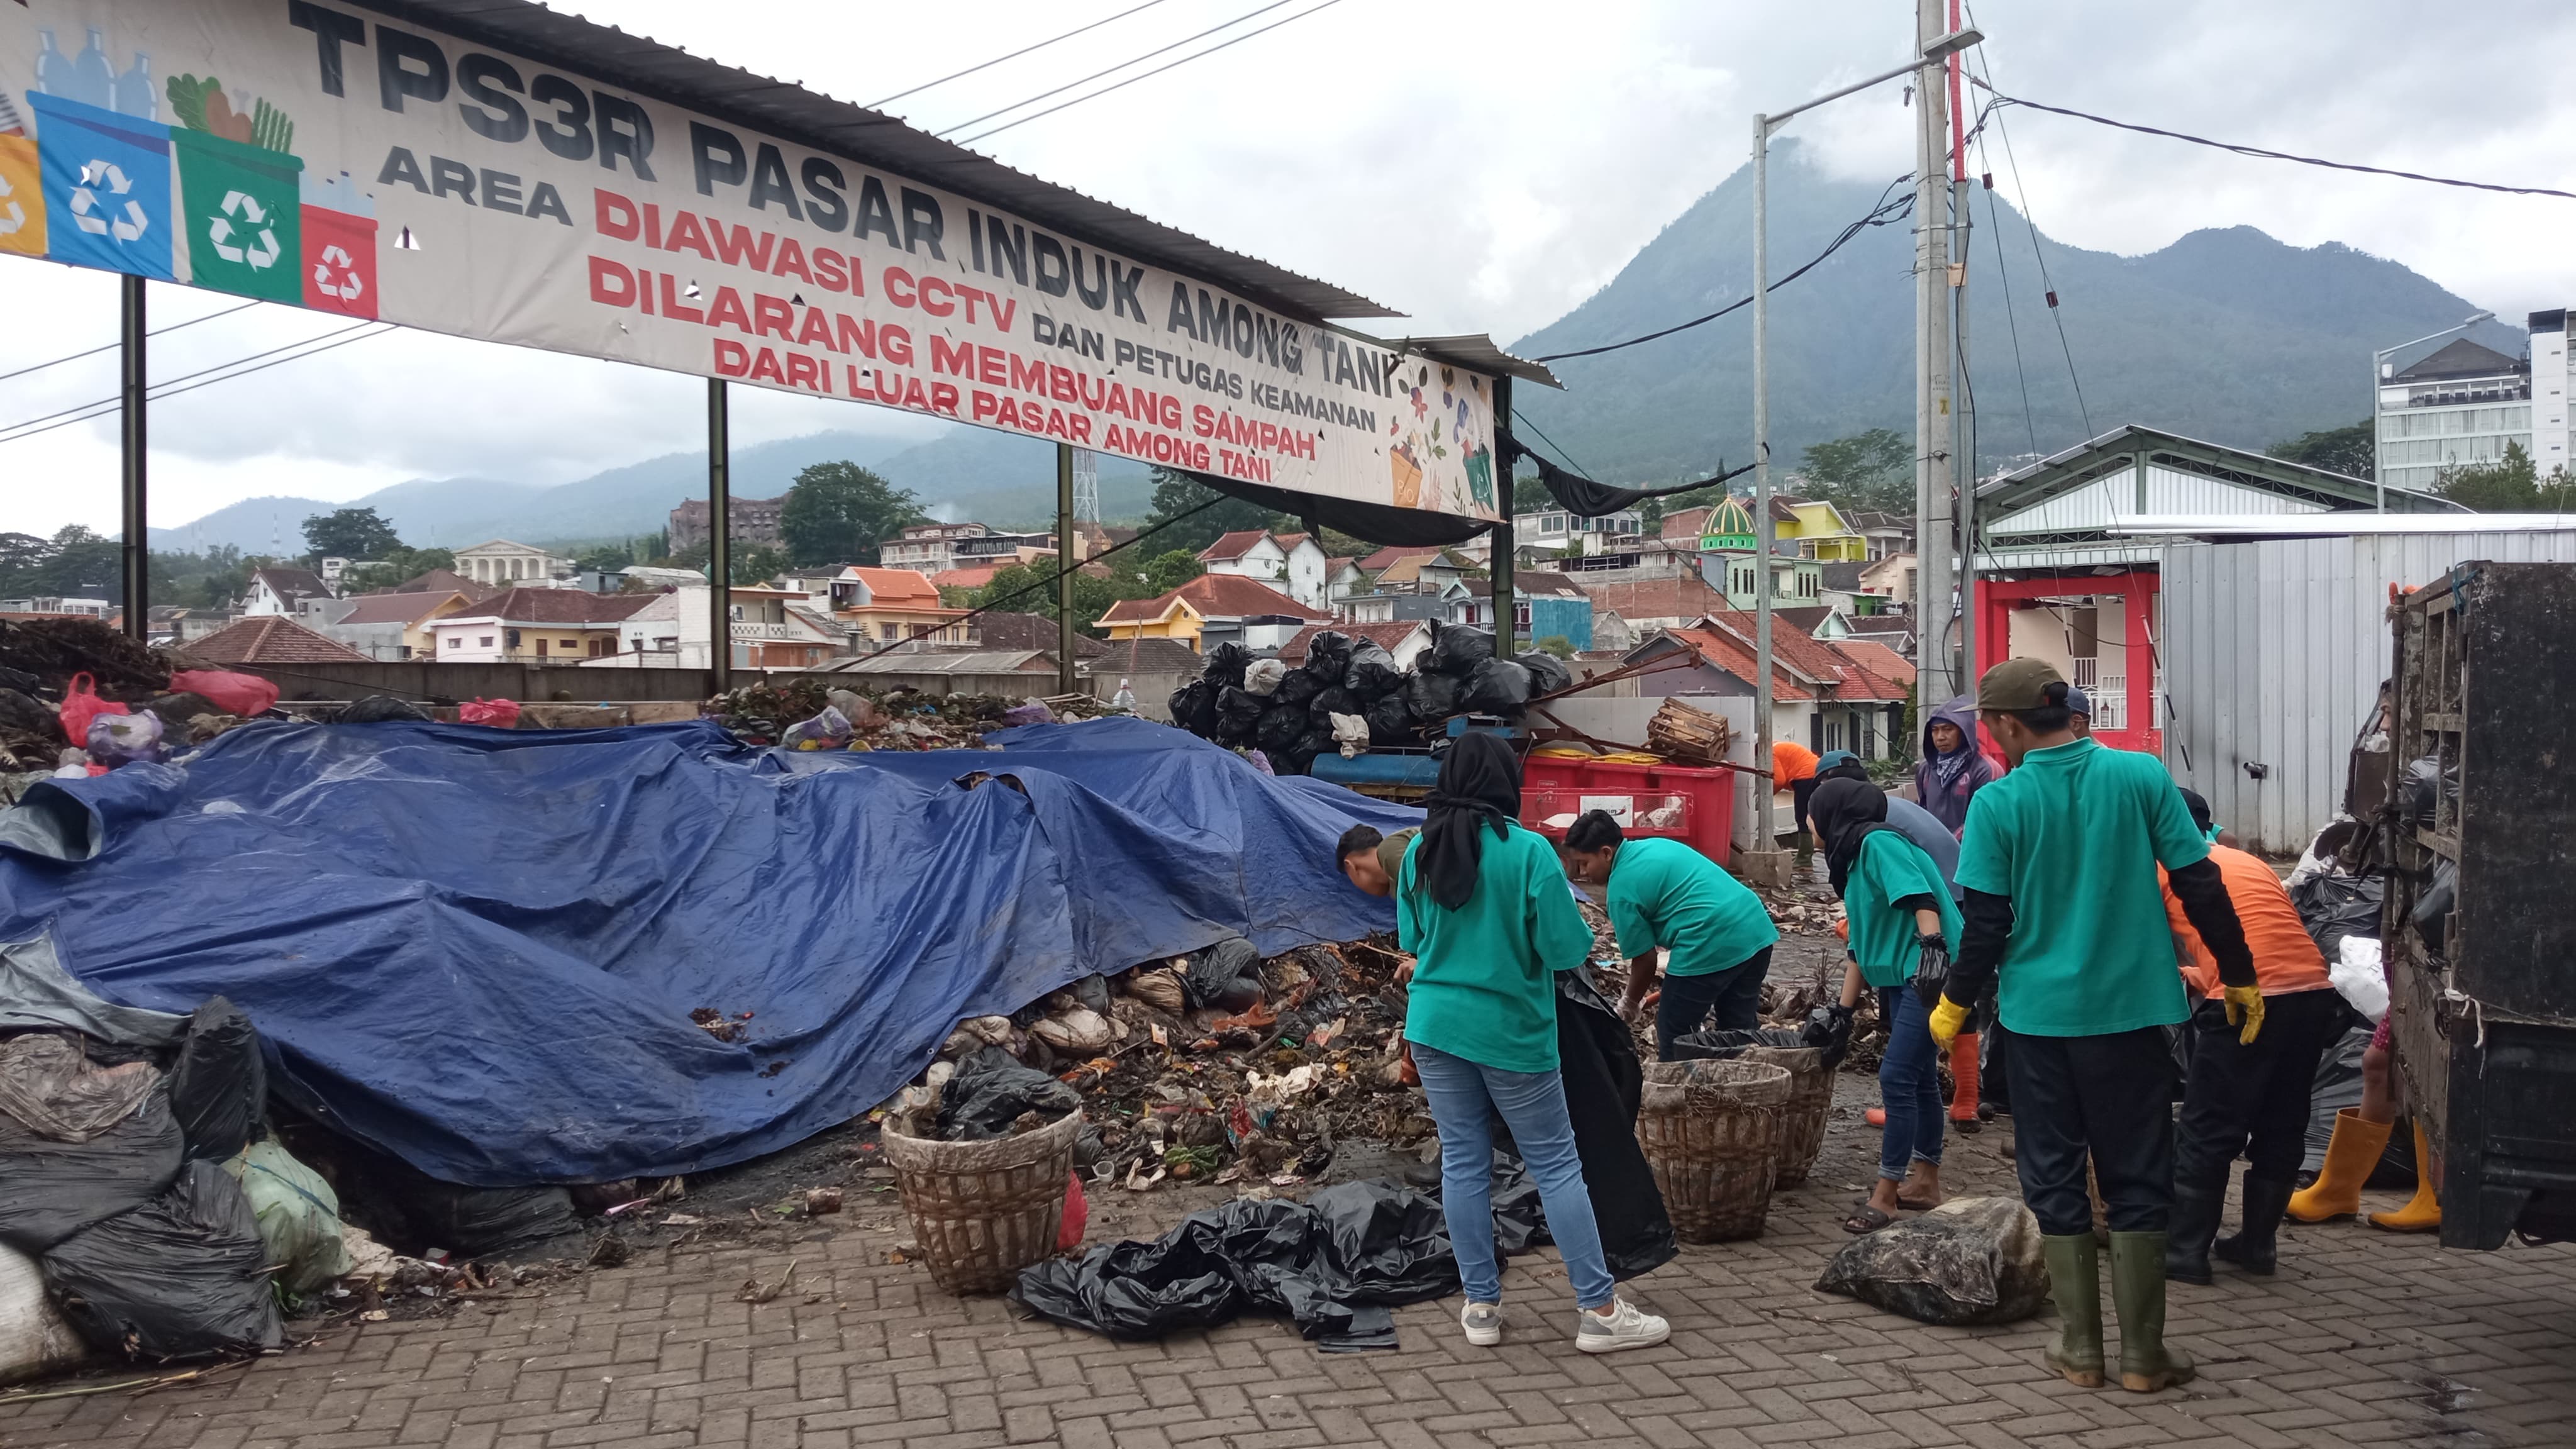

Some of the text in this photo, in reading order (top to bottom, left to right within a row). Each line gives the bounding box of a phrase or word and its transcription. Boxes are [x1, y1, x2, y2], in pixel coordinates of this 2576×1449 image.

[289, 0, 1392, 398] TPS3R PASAR INDUK AMONG TANI
[377, 145, 1376, 433] AREA DIAWASI CCTV DAN PETUGAS KEAMANAN
[588, 255, 1316, 460] DILARANG MEMBUANG SAMPAH
[713, 338, 1271, 482] DARI LUAR PASAR AMONG TANI
[1397, 479, 1414, 502] BIO
